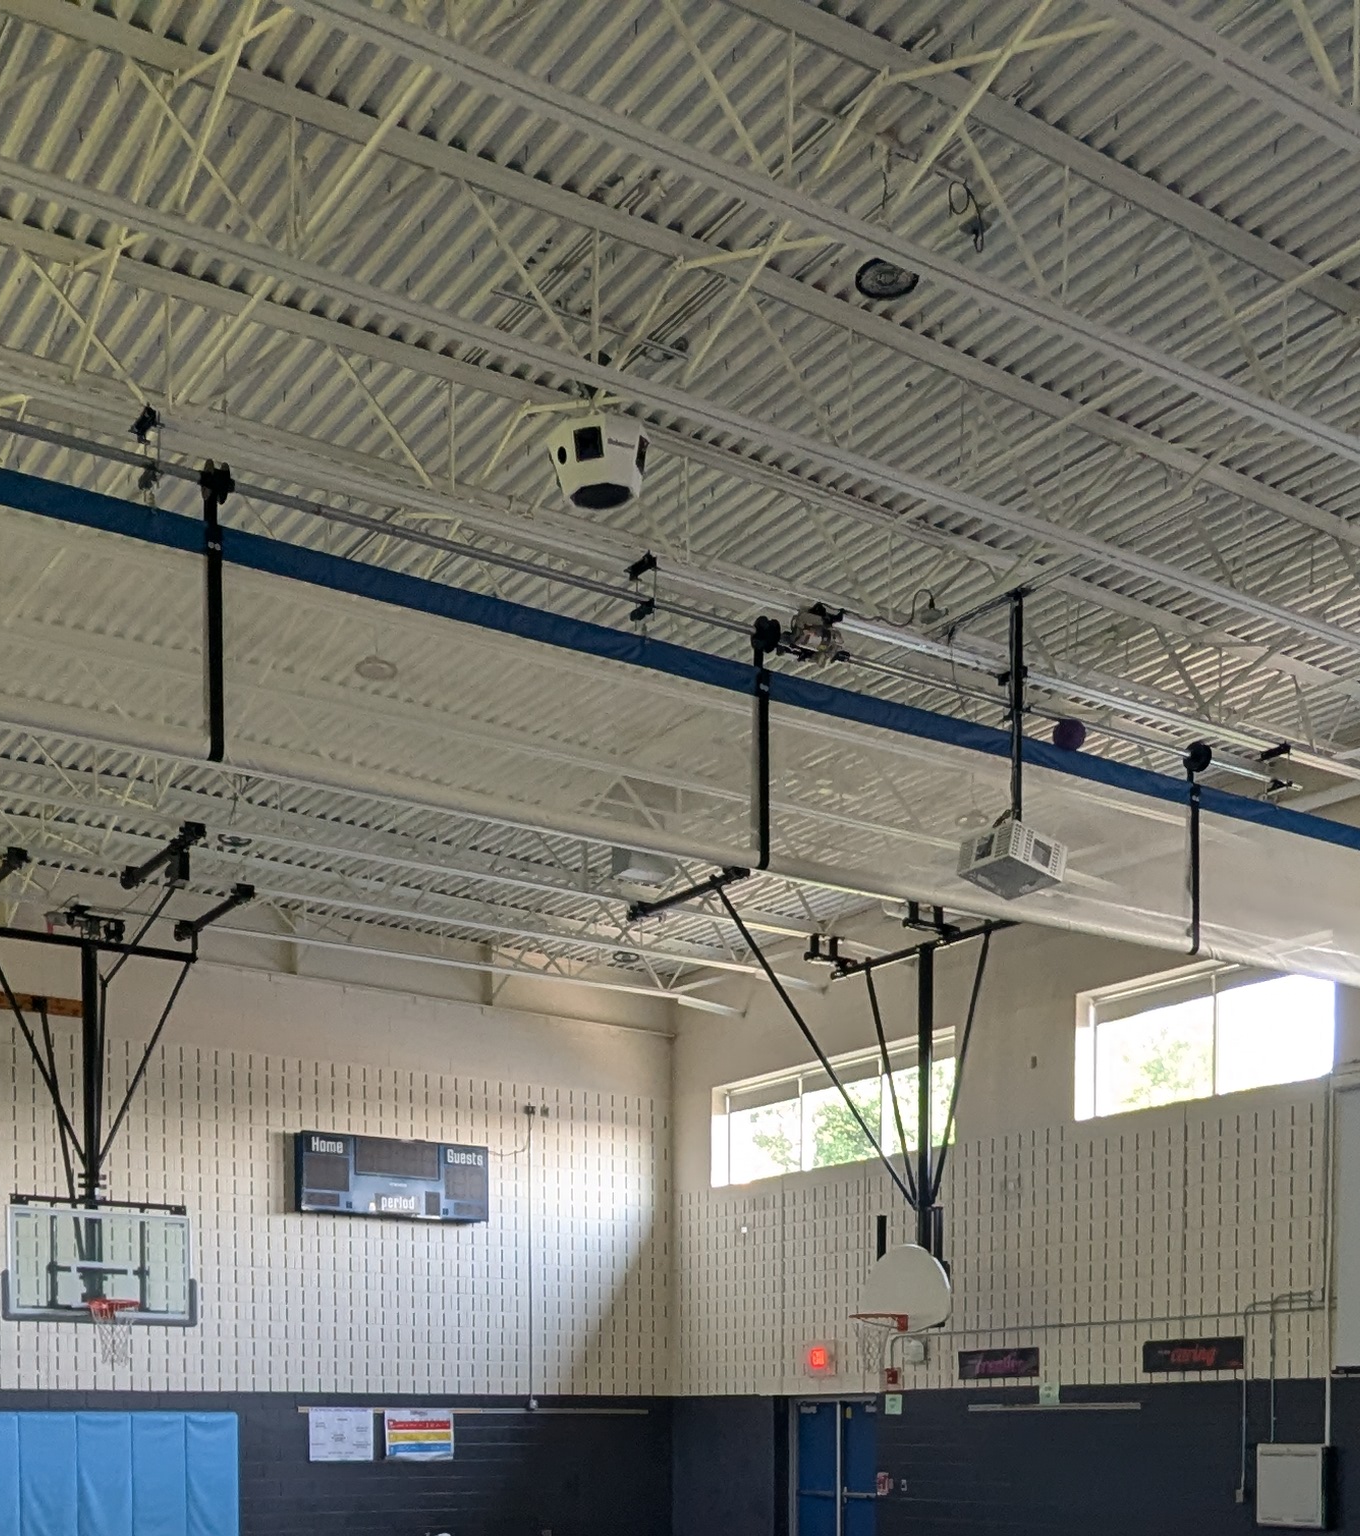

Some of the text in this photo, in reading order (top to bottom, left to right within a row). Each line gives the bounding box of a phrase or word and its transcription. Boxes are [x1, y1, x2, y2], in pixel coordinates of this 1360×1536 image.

[311, 1136, 344, 1154] Home
[446, 1149, 484, 1166] Guests
[381, 1196, 415, 1211] period
